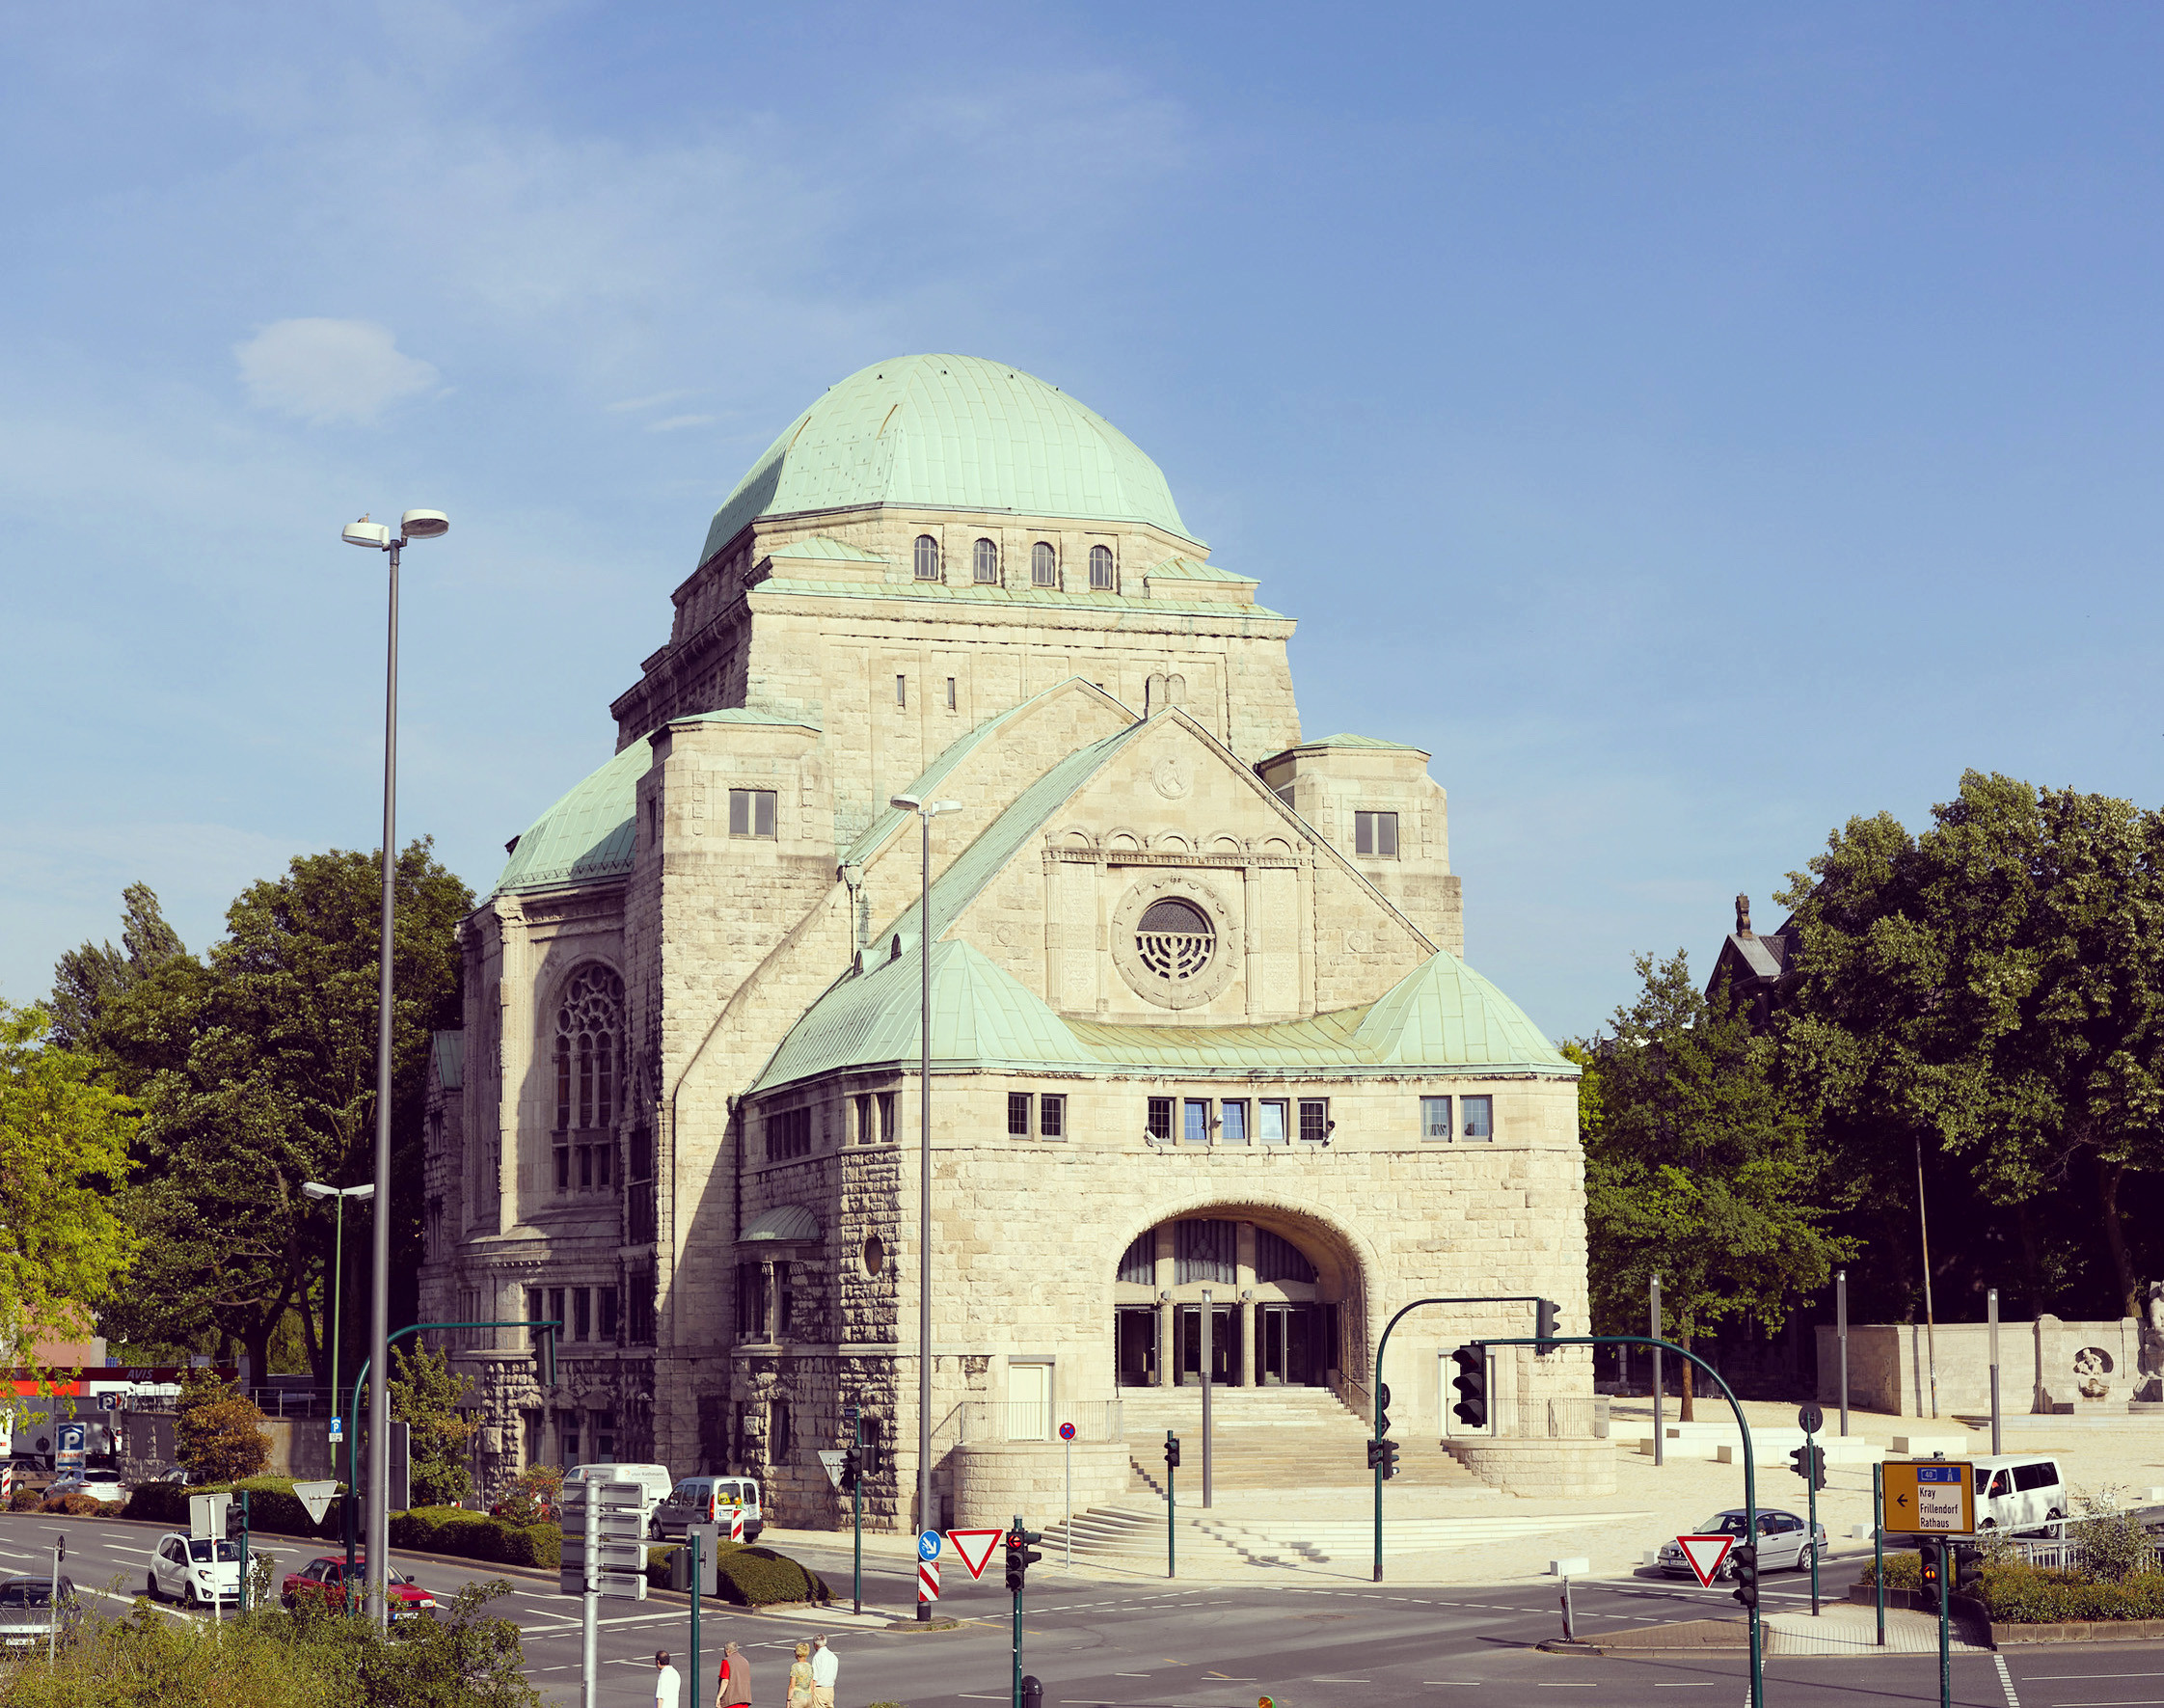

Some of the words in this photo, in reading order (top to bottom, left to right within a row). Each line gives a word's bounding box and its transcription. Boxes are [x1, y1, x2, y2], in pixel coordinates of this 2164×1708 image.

[126, 1369, 153, 1379] AVIS
[65, 1432, 80, 1450] P
[1919, 1487, 1936, 1500] Kray
[1920, 1504, 1959, 1514] Frillendorf
[1920, 1517, 1950, 1528] Rathaus
